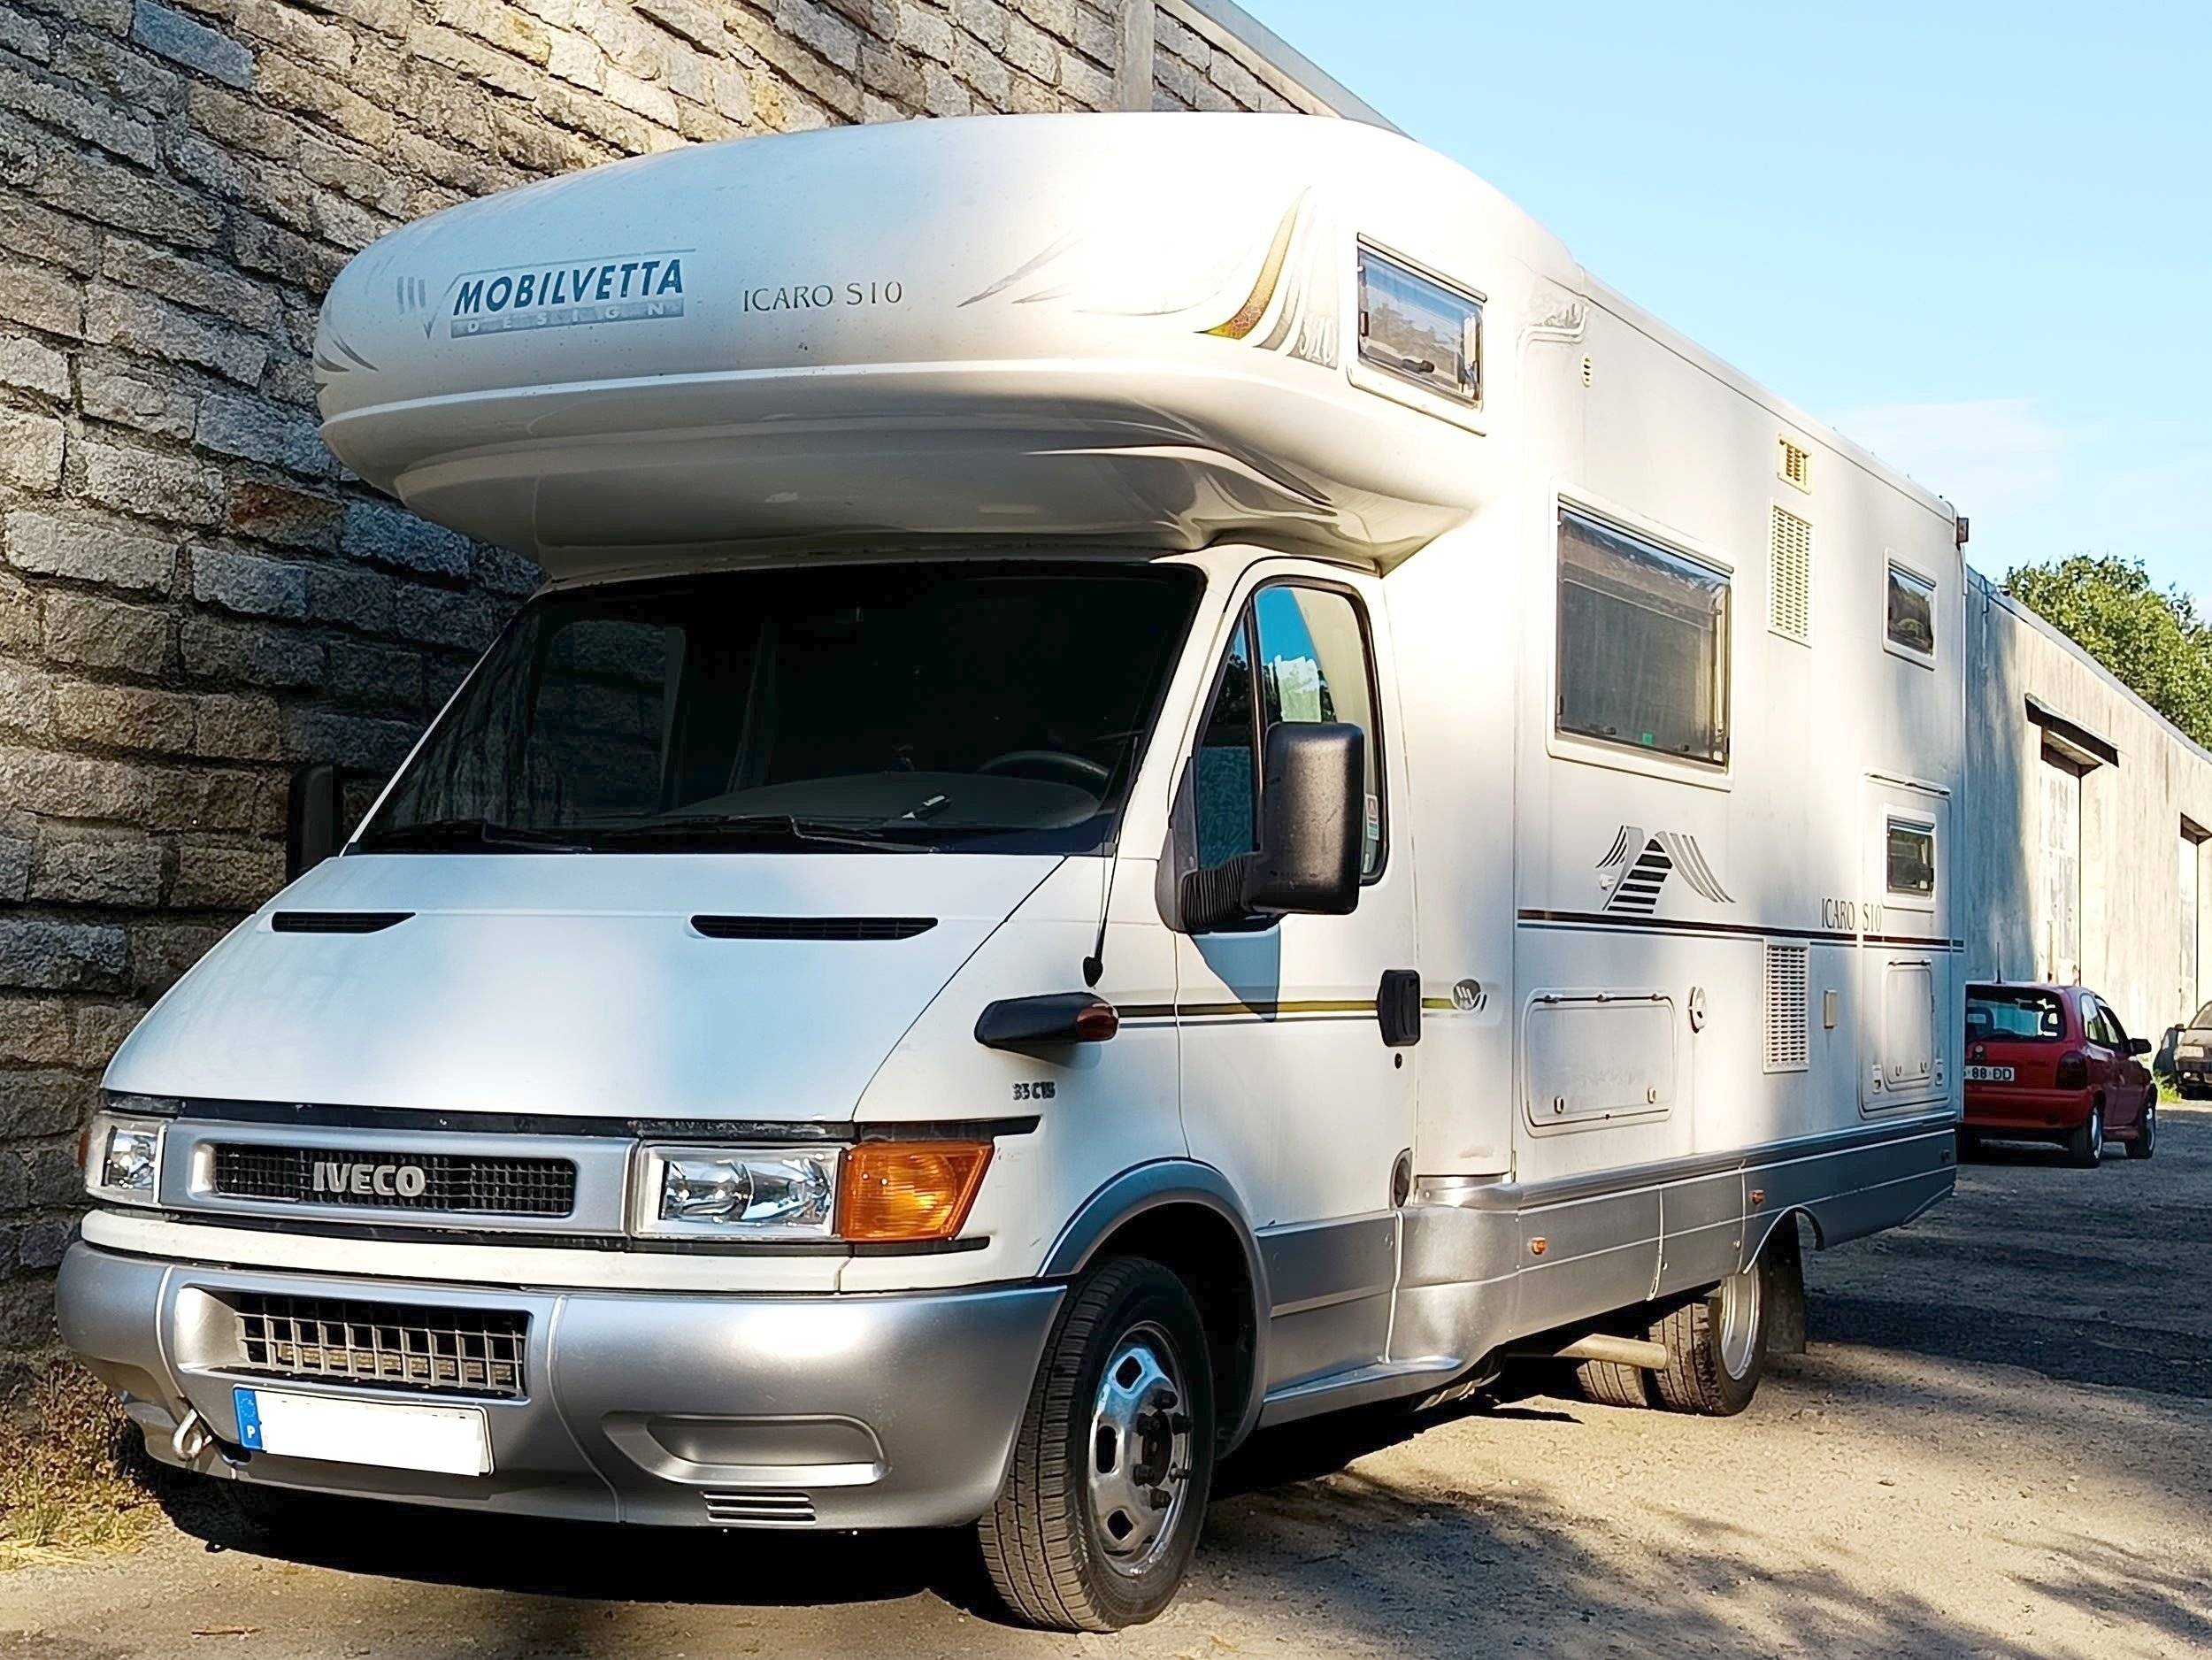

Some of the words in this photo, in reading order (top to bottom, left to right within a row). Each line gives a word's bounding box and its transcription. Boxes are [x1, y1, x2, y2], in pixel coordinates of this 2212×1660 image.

[453, 258, 683, 316] MOBILVETTA
[743, 285, 833, 312] ICARO
[846, 281, 902, 305] S10
[466, 302, 664, 334] DESIGN
[1821, 897, 1855, 931] ICARO
[1862, 903, 1882, 933] S10
[312, 1161, 426, 1197] IVECO
[246, 1424, 256, 1439] P
